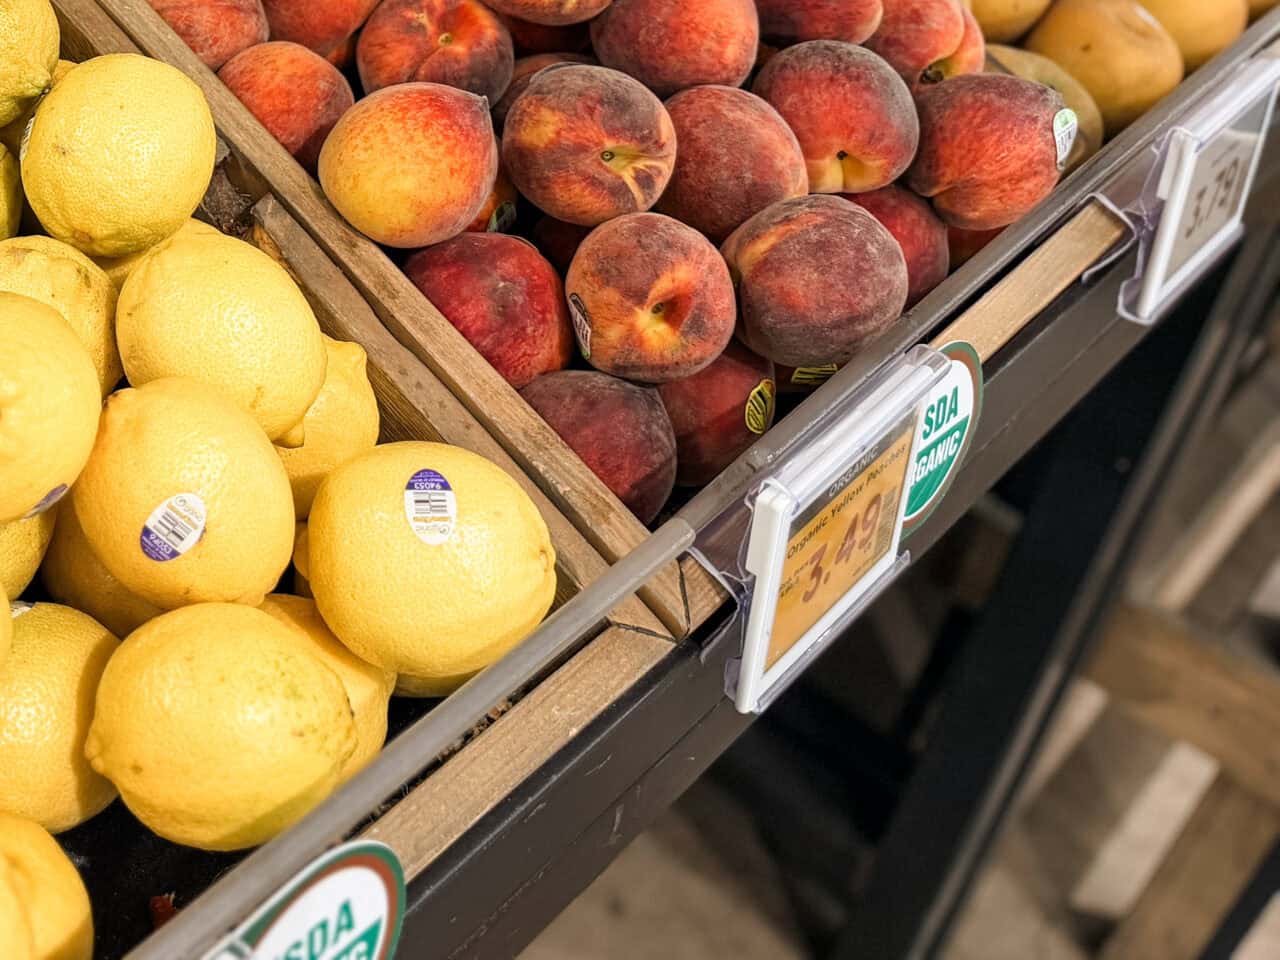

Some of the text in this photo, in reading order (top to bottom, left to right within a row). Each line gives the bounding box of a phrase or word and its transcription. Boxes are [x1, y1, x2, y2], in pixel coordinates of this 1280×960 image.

[922, 386, 959, 441] SDA
[828, 446, 880, 497] ORGANIC
[910, 430, 960, 487] RGANIC
[786, 443, 907, 559] Organic Yellow Peaches
[802, 493, 882, 603] 3.49
